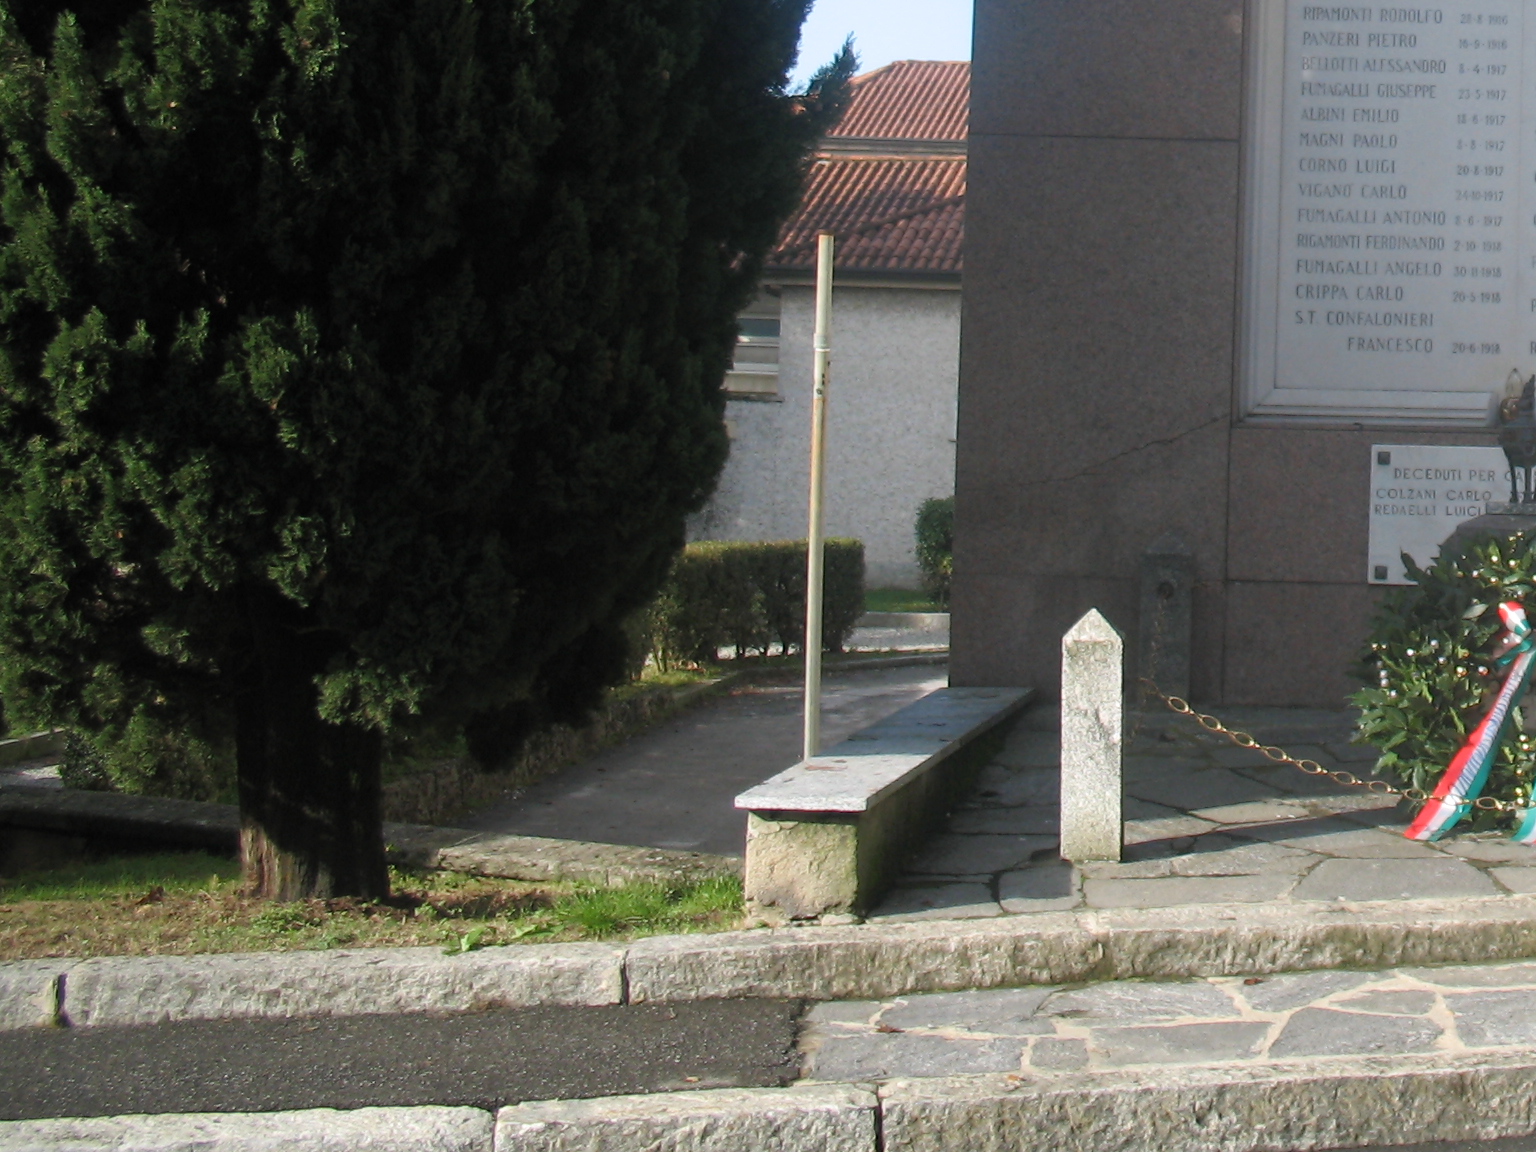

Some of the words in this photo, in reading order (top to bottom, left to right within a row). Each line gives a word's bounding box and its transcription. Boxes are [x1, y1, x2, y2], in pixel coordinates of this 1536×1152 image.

[1304, 7, 1372, 22] RIPAMONTI
[1380, 9, 1443, 24] RODOLFO
[1303, 32, 1359, 46] PANZERI
[1368, 33, 1417, 48] PIETRO
[1302, 57, 1358, 71] BELLOTTI
[1363, 59, 1446, 74] ALESSANDRO
[1302, 83, 1369, 97] FUMAGALLI
[1377, 84, 1437, 99] GIUSEPPE
[1301, 108, 1345, 122] ALBINI
[1353, 109, 1399, 123] EMILIO
[1300, 133, 1344, 147] MAGNI
[1353, 135, 1398, 148] PAOLO
[1299, 158, 1347, 173] CORNO
[1357, 160, 1395, 174] LUIGI
[1361, 185, 1407, 199] CARLO
[1298, 209, 1376, 223] FUMAGALLI
[1383, 210, 1446, 226] ANTONIO
[1297, 234, 1360, 249] RIGAMONTI
[1367, 236, 1444, 251] FERDINANDO
[1296, 260, 1377, 275] FUMAGALLI
[1385, 262, 1442, 277] ANGELO
[1296, 285, 1348, 299] CRIPPA
[1357, 286, 1404, 301] CARLO
[1327, 311, 1434, 327] CONFALONIERI
[1348, 338, 1433, 353] FRANCESCO
[1394, 468, 1462, 481] DECEDUTI
[1469, 470, 1495, 483] PER
[1376, 488, 1436, 499] COLZANI
[1446, 490, 1492, 502] CARLO
[1375, 505, 1436, 516] REDAELLI
[1446, 506, 1482, 517] LUIGI
